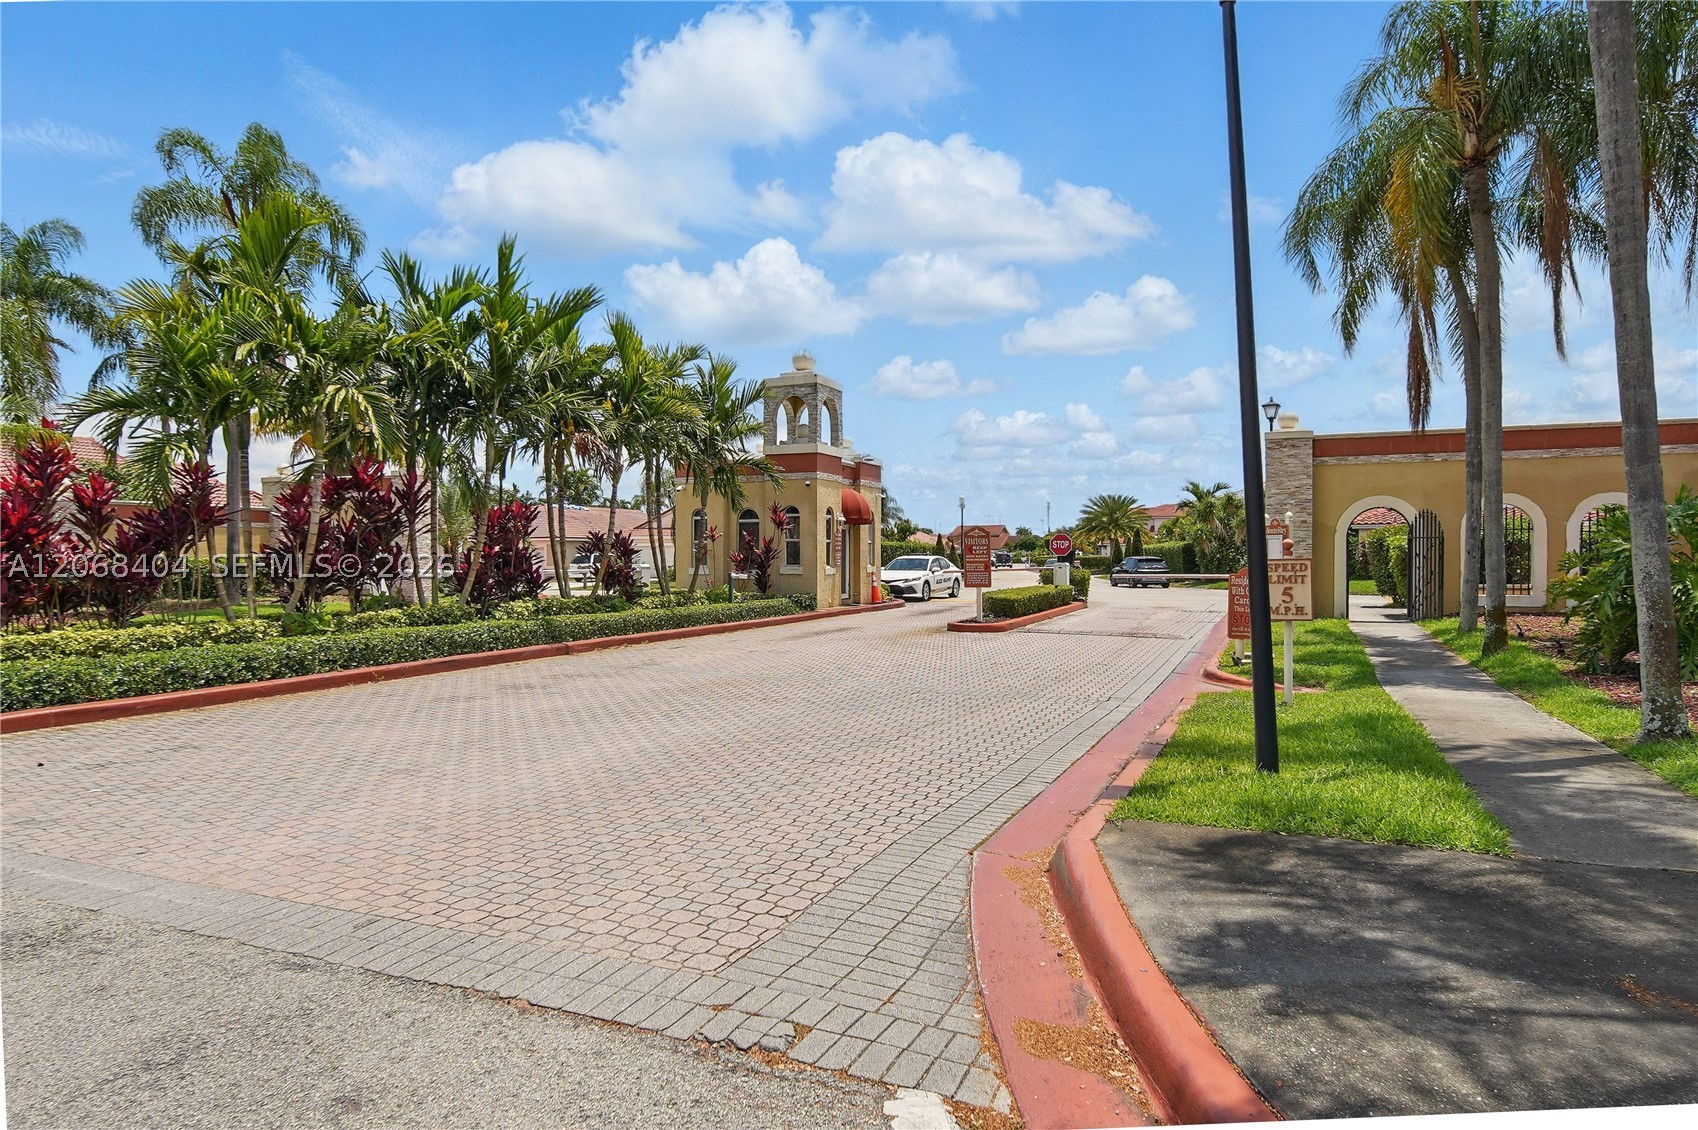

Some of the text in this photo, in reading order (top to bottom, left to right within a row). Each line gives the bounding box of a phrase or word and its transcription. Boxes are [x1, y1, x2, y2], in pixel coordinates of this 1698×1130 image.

[964, 537, 988, 545] VISITORS
[1052, 540, 1070, 549] STOP
[1268, 563, 1308, 572] SPEED
[1268, 575, 1307, 584] LIMIT
[1231, 587, 1244, 595] With
[1281, 587, 1294, 603] 5
[1270, 606, 1308, 615] M.P.H.
